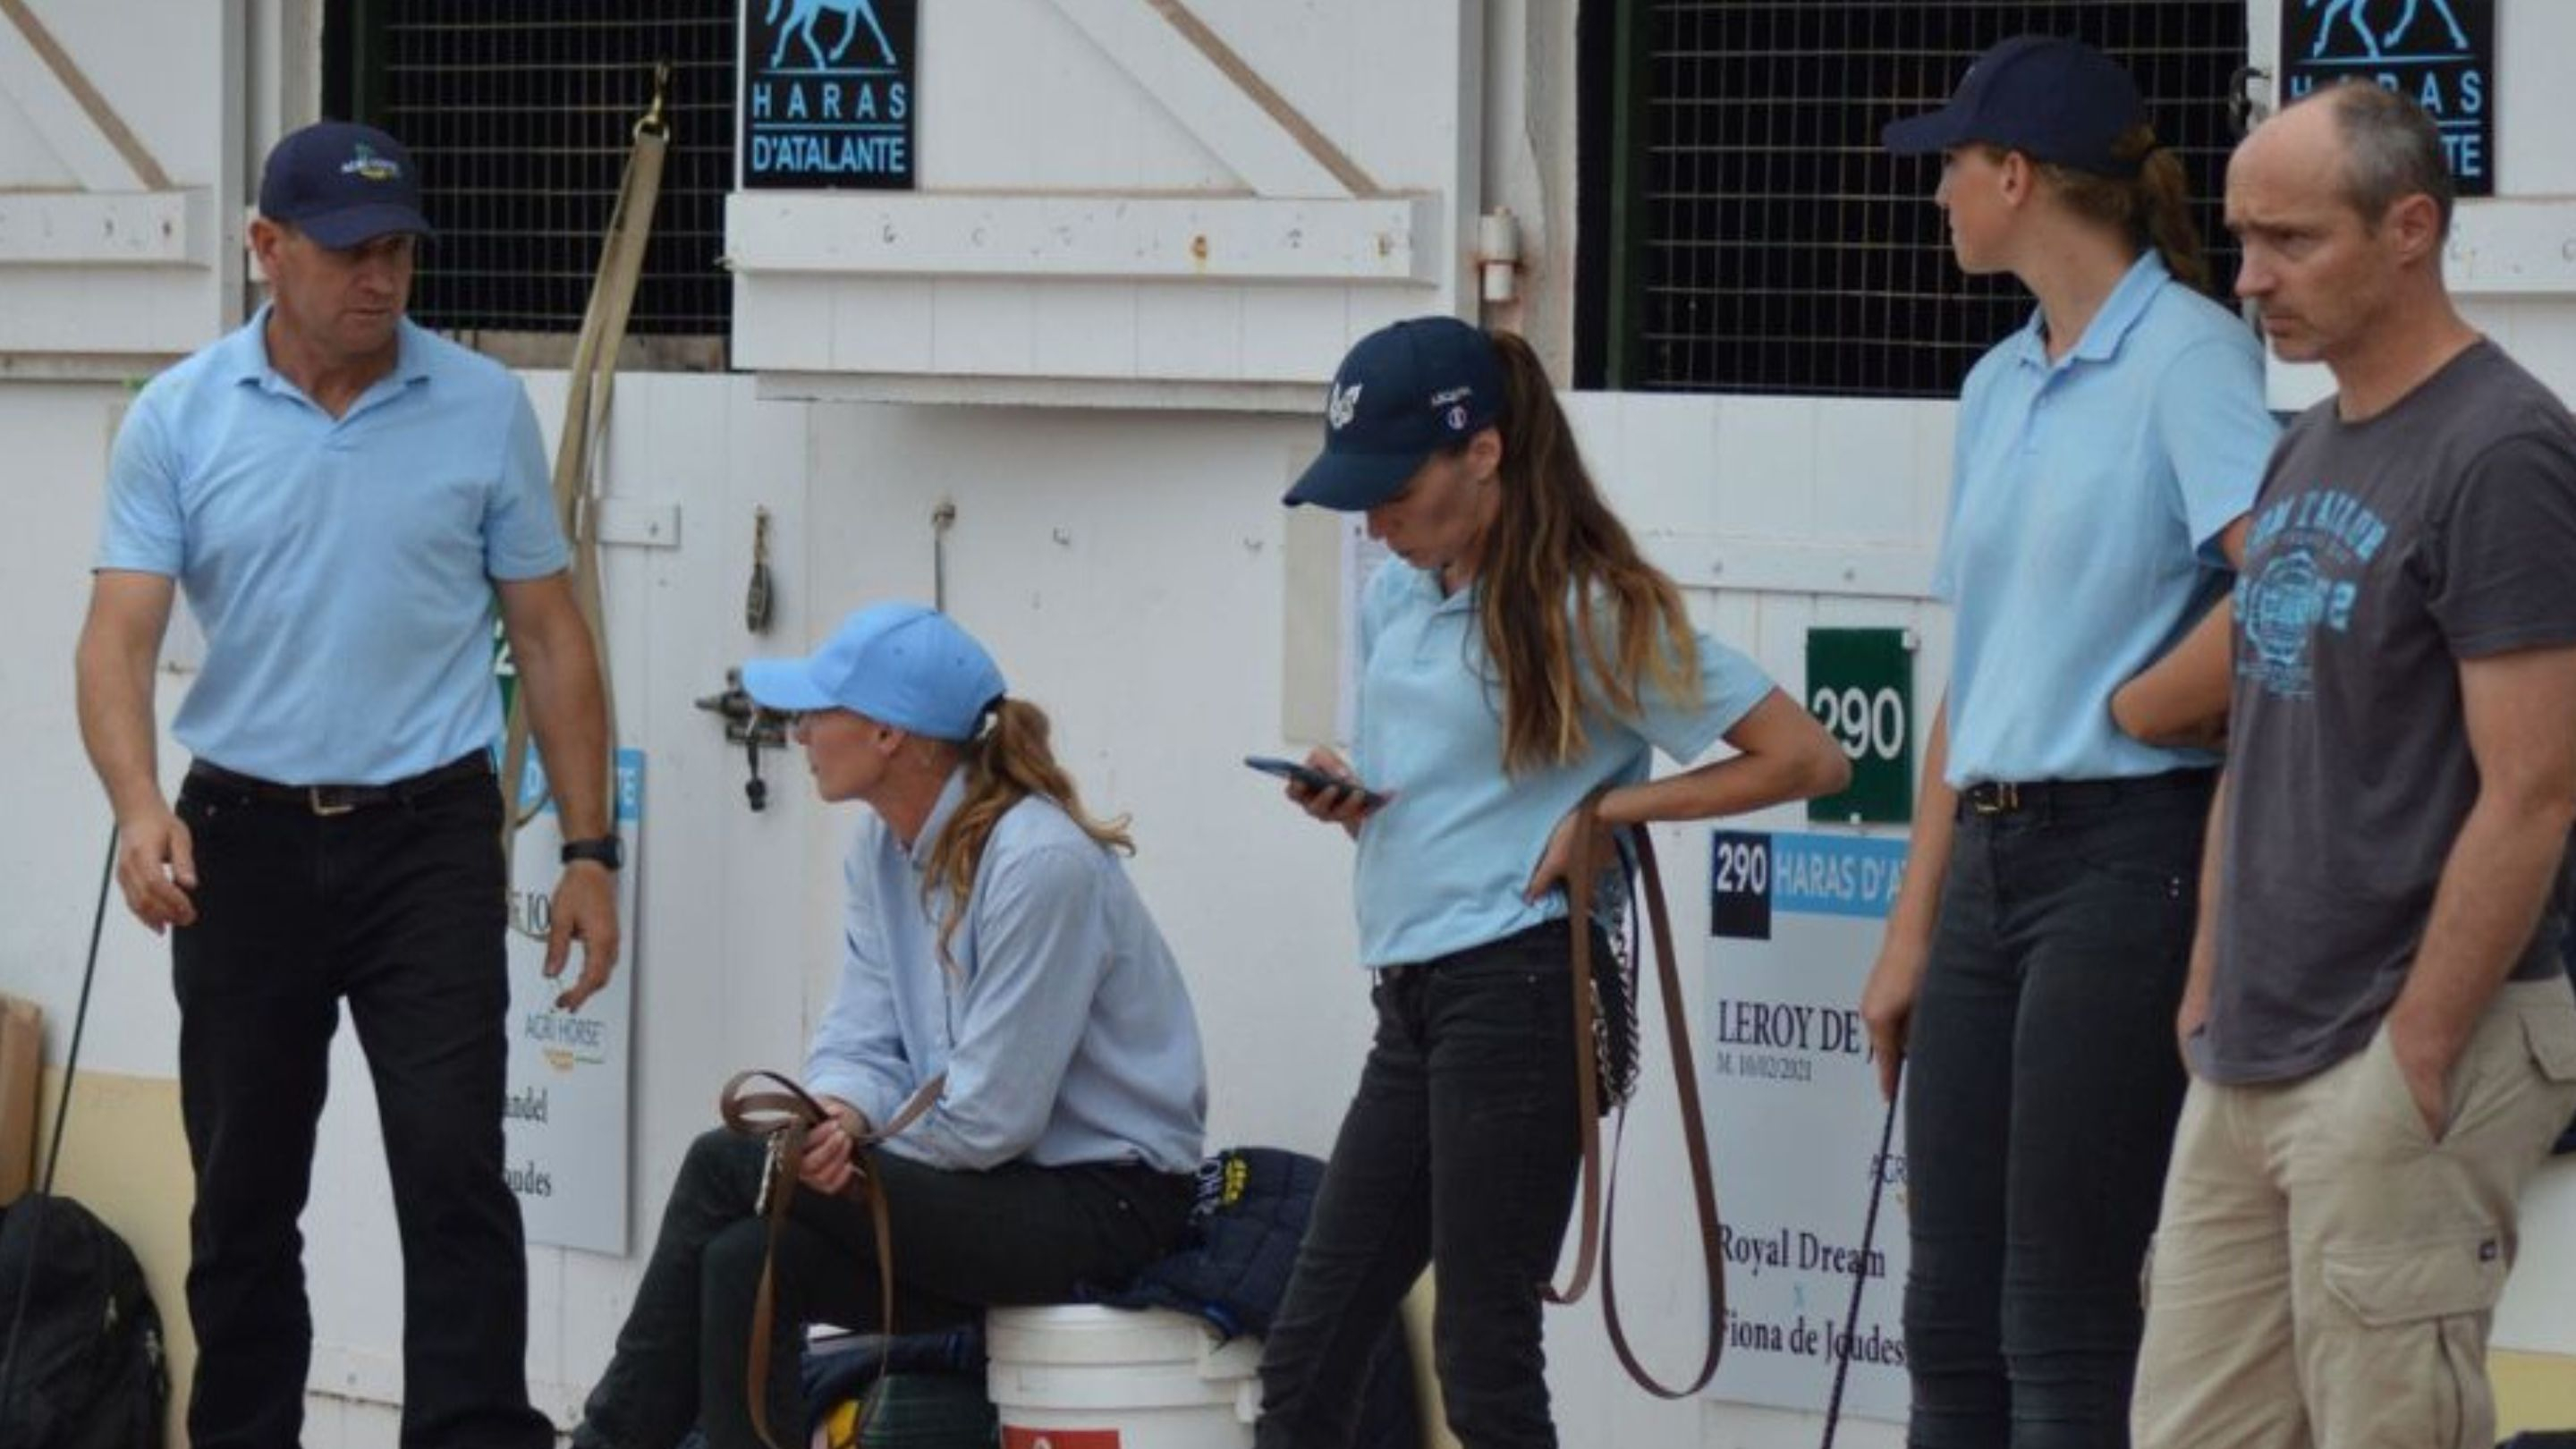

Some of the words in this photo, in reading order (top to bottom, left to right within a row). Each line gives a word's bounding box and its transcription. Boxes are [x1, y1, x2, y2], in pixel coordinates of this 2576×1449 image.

[752, 82, 907, 119] HARAS
[752, 137, 906, 173] D'ATALANTE
[1813, 687, 1904, 760] 290
[1716, 843, 1767, 894] 290
[1775, 852, 1854, 900] HARAS
[1719, 999, 1812, 1049] LEROY
[1820, 1009, 1860, 1054] DE
[1717, 1222, 1789, 1277] Royal
[1799, 1232, 1886, 1278] Dream
[1725, 1308, 1784, 1353] iona
[1790, 1315, 1818, 1356] de
[1825, 1318, 1908, 1367] Joudes
